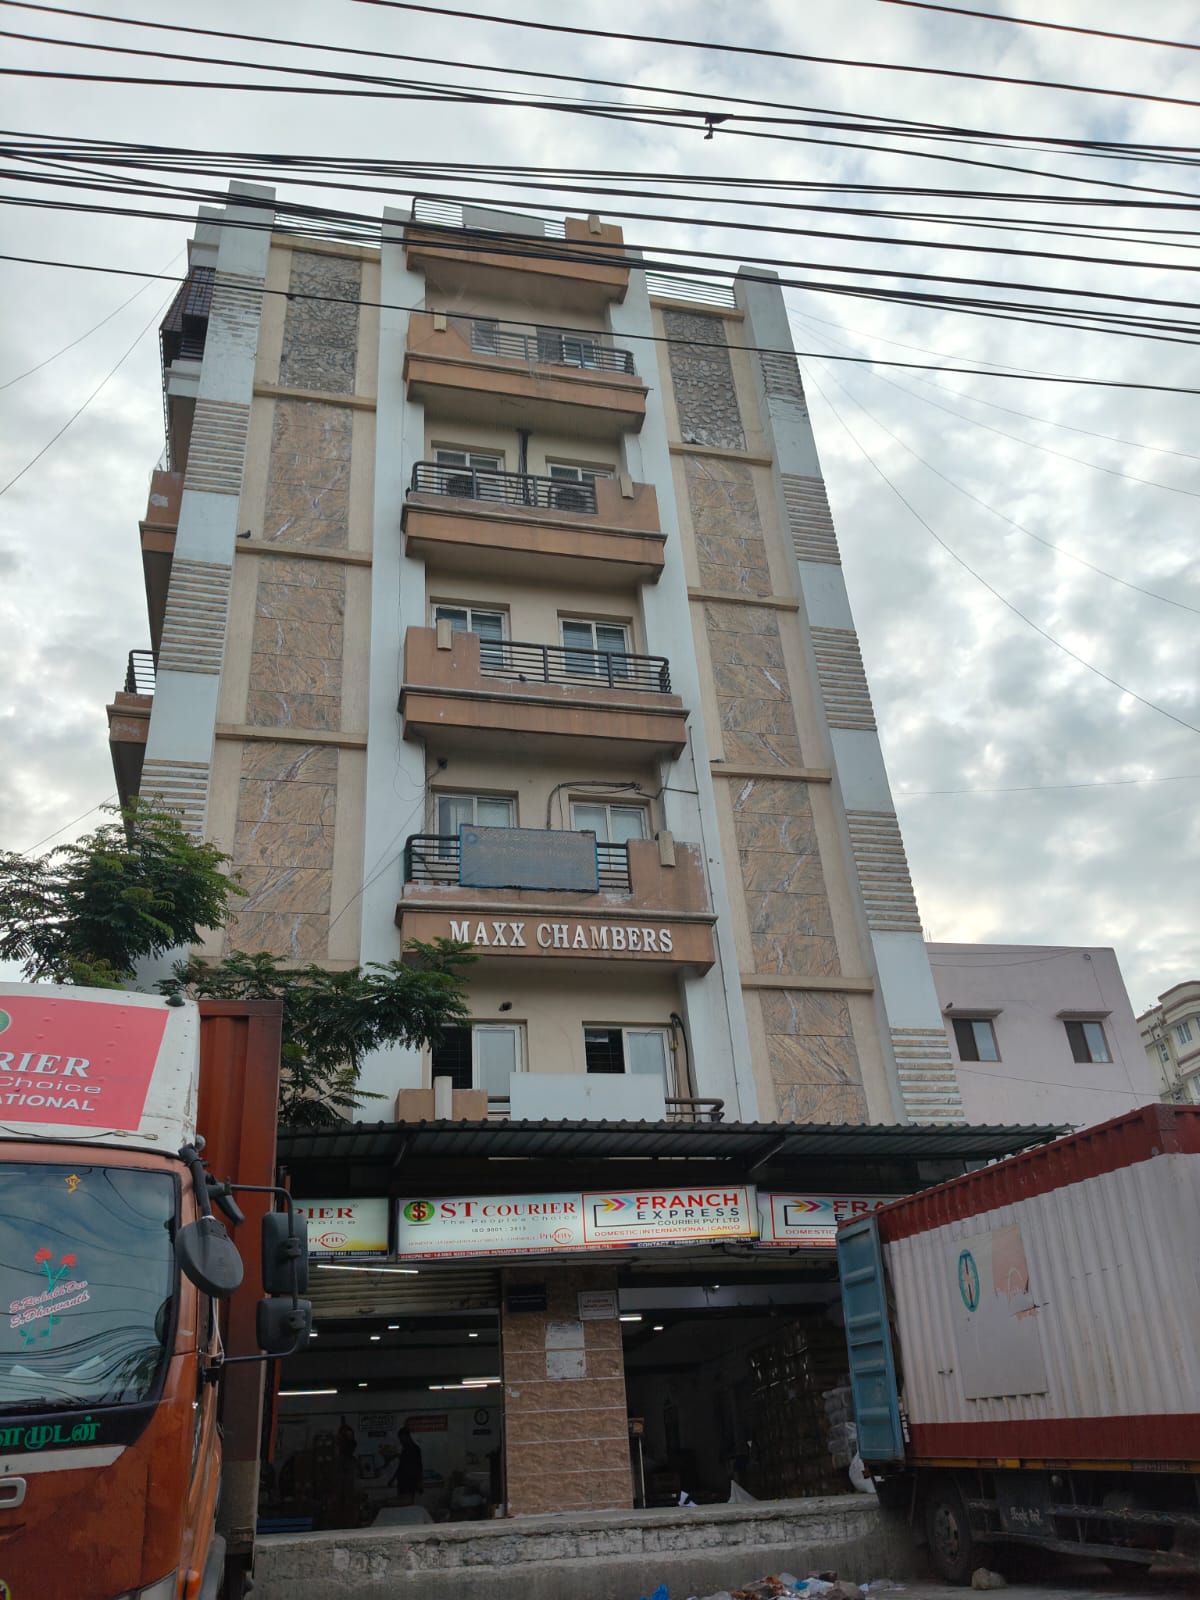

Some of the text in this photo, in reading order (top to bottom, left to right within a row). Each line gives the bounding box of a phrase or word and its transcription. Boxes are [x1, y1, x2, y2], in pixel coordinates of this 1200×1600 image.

[450, 920, 673, 952] MAXX CHAMBERS
[0, 1093, 96, 1111] TIONAL
[635, 1193, 739, 1211] FRANCH
[296, 1207, 355, 1219] IER
[440, 1202, 479, 1219] ST
[482, 1201, 576, 1218] COURIER
[637, 1207, 740, 1220] EXPRESS
[657, 1216, 740, 1226] COURIER PVT LTD
[711, 1224, 741, 1232] CARGO
